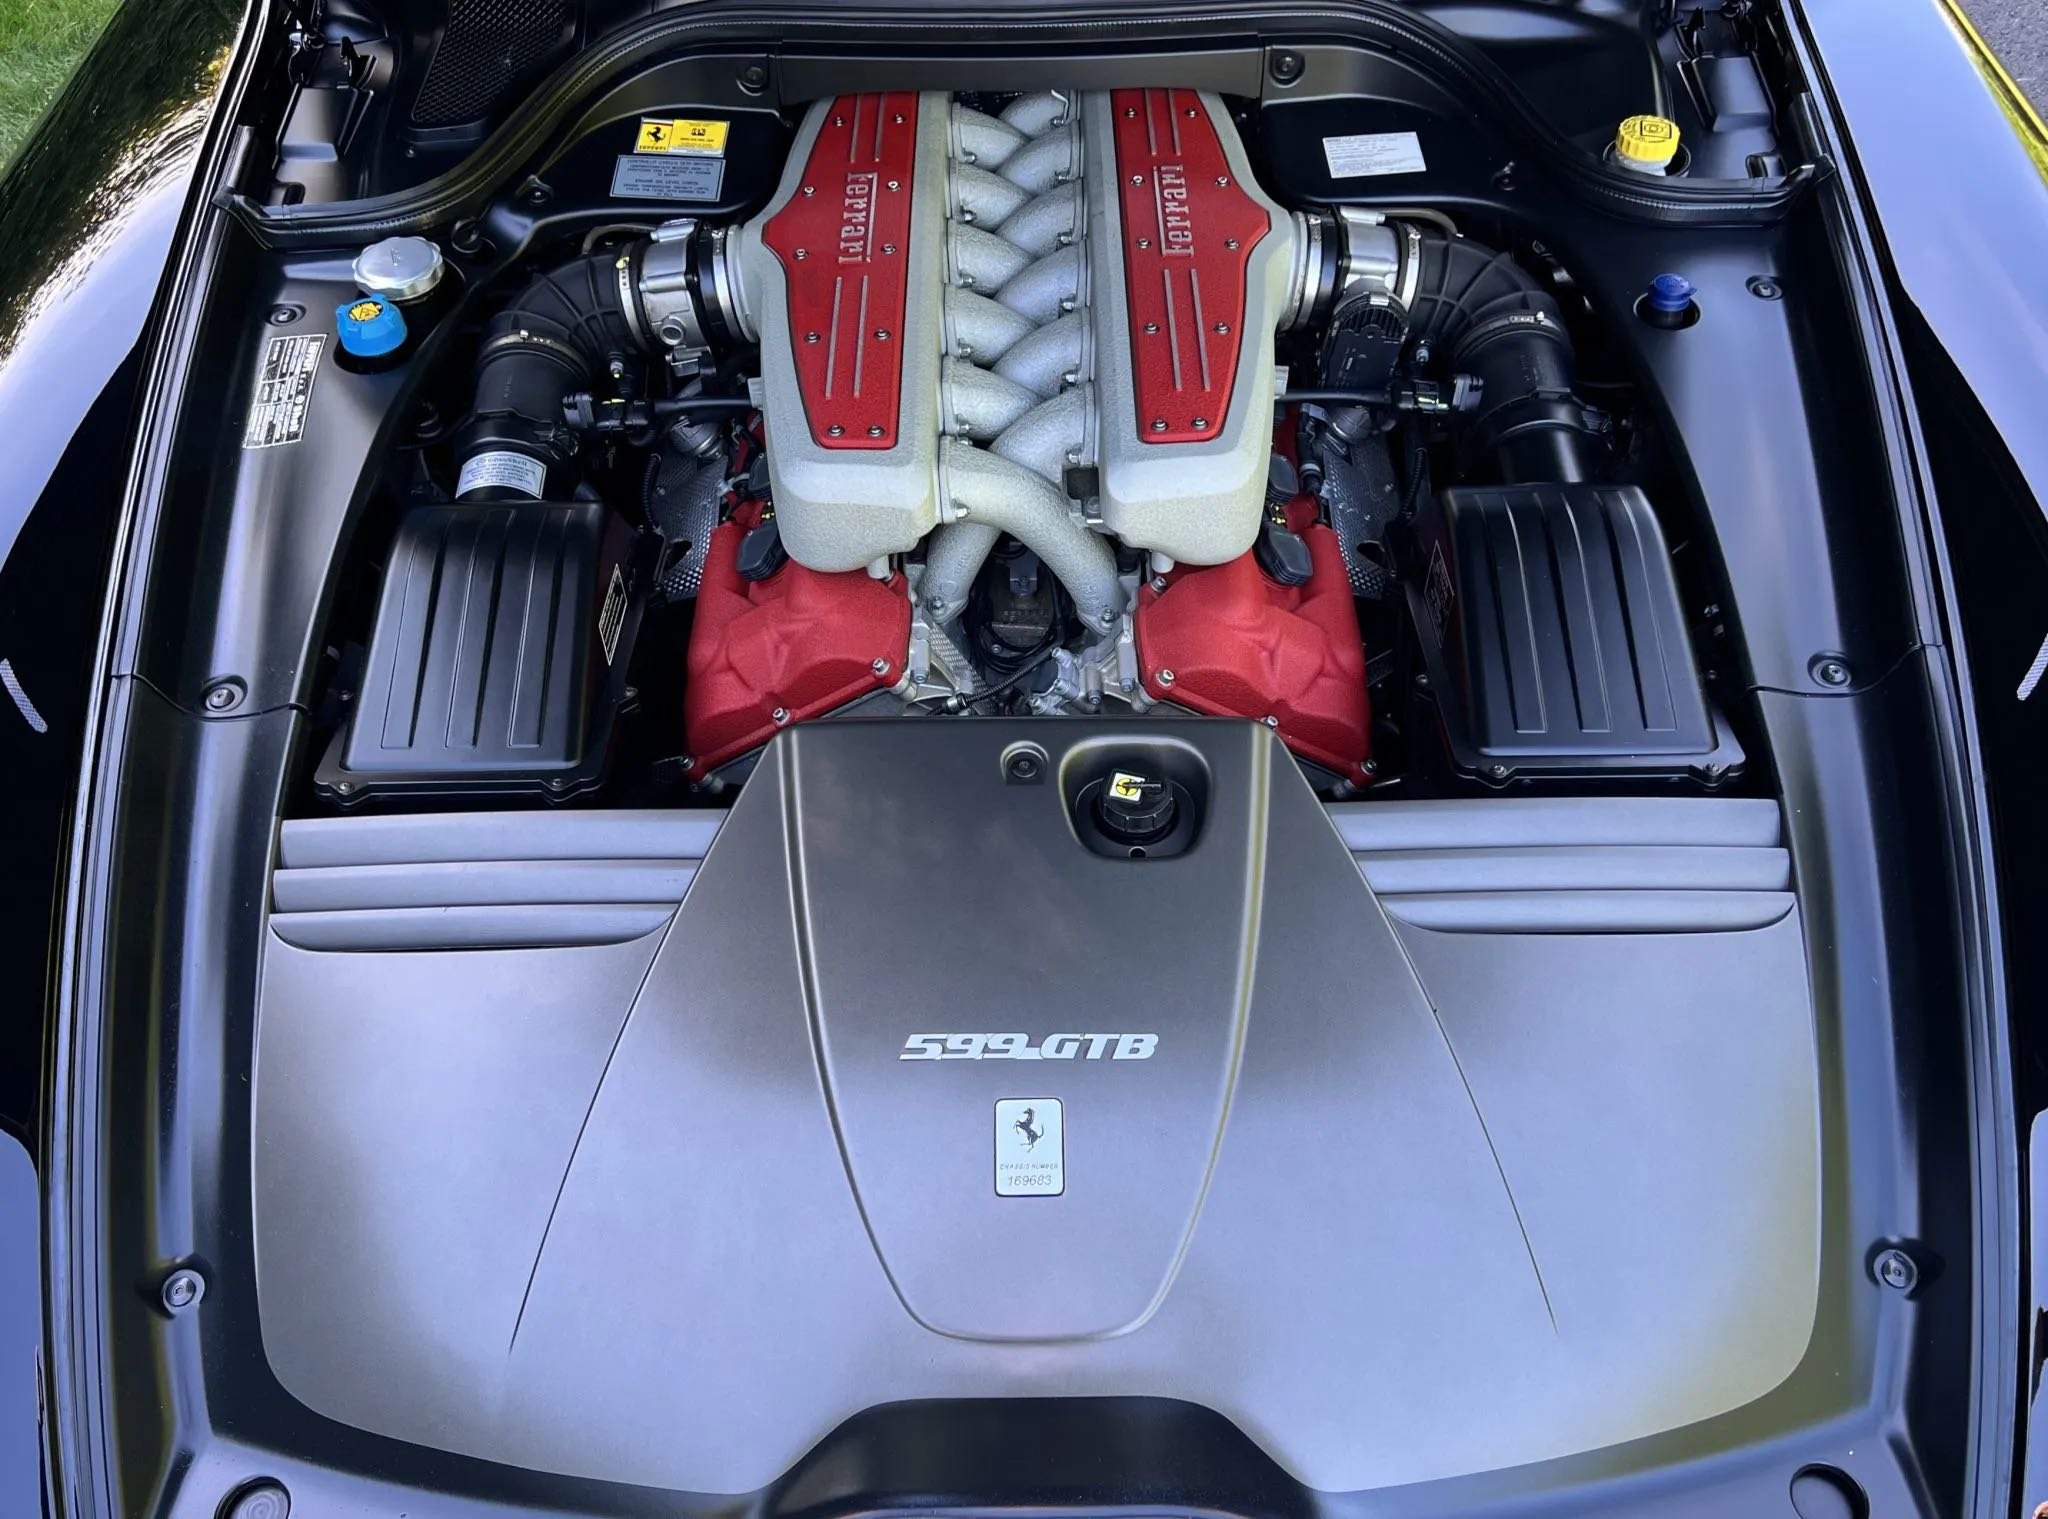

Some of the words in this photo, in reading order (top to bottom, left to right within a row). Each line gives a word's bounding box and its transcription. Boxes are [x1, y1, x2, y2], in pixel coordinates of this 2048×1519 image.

[838, 172, 878, 264] Ferrari
[1153, 164, 1194, 257] Ferrari
[899, 1033, 1030, 1060] 599
[1040, 1033, 1159, 1060] GTB
[1008, 1174, 1053, 1186] 169683
